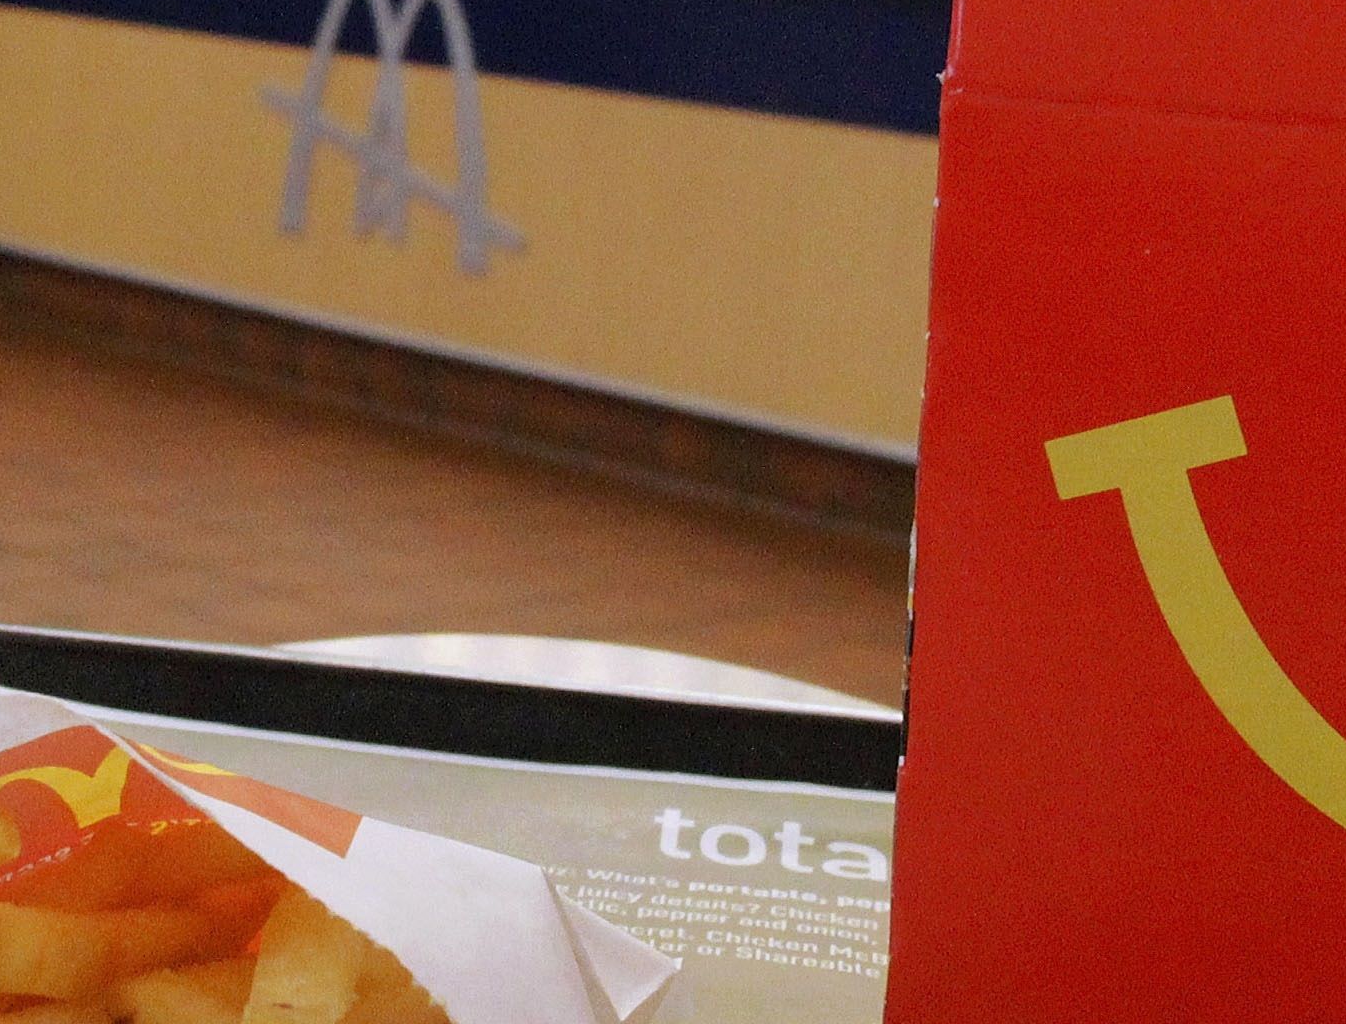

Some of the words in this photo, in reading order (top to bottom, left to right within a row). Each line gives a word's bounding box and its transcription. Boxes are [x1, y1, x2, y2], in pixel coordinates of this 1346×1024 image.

[654, 807, 888, 882] tota
[587, 869, 680, 889] What's
[689, 882, 827, 906] portable,
[577, 885, 643, 904] juicy
[652, 894, 760, 914] details?
[770, 905, 878, 930] Chicken
[637, 907, 730, 924] pepper
[739, 917, 787, 931] and
[796, 923, 878, 945] onion,
[707, 930, 818, 953] Chicken
[697, 945, 724, 957] or
[736, 946, 881, 978] Shareable
